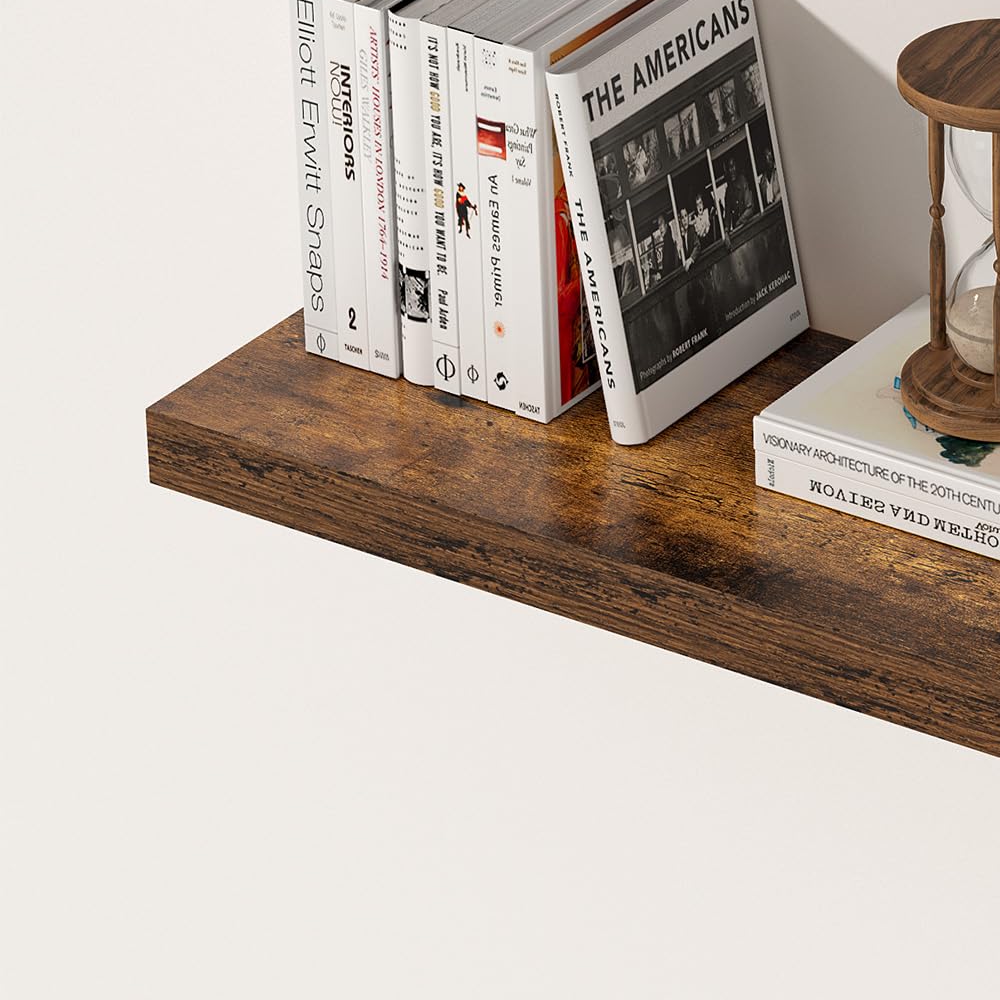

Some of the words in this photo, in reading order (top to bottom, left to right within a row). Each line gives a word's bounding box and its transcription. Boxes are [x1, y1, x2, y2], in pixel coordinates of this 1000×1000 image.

[428, 53, 439, 70] NOT
[429, 71, 440, 90] HOW
[430, 91, 441, 112] GOOD
[582, 73, 625, 122] THE
[372, 86, 382, 137] HOUSES
[431, 114, 441, 130] YOU
[302, 99, 321, 193] Erwitt
[555, 93, 566, 136] ROBERT
[564, 140, 573, 177] FRANK
[374, 140, 382, 154] IN
[375, 157, 385, 211] LONDON
[433, 168, 443, 187] HOW
[433, 187, 444, 209] GOOD
[435, 211, 445, 227] YOU
[436, 229, 446, 251] WANT
[306, 204, 325, 312] Snaps
[436, 252, 447, 263] TO
[575, 198, 588, 242] THE
[584, 252, 615, 389] AMERICANS
[756, 287, 769, 301] JACK
[768, 270, 791, 291] KEROUAC
[438, 288, 448, 306] Paul
[348, 307, 357, 330] 2
[439, 307, 449, 330] Arden
[344, 343, 363, 355] TASCHEN
[672, 339, 691, 360] ROBERT
[691, 327, 708, 345] FRANK
[763, 433, 812, 456] VISIONARY
[813, 448, 890, 481] ARCHITECTURE
[891, 471, 905, 485] OF
[907, 475, 928, 493] THE
[930, 482, 961, 501] 20TH
